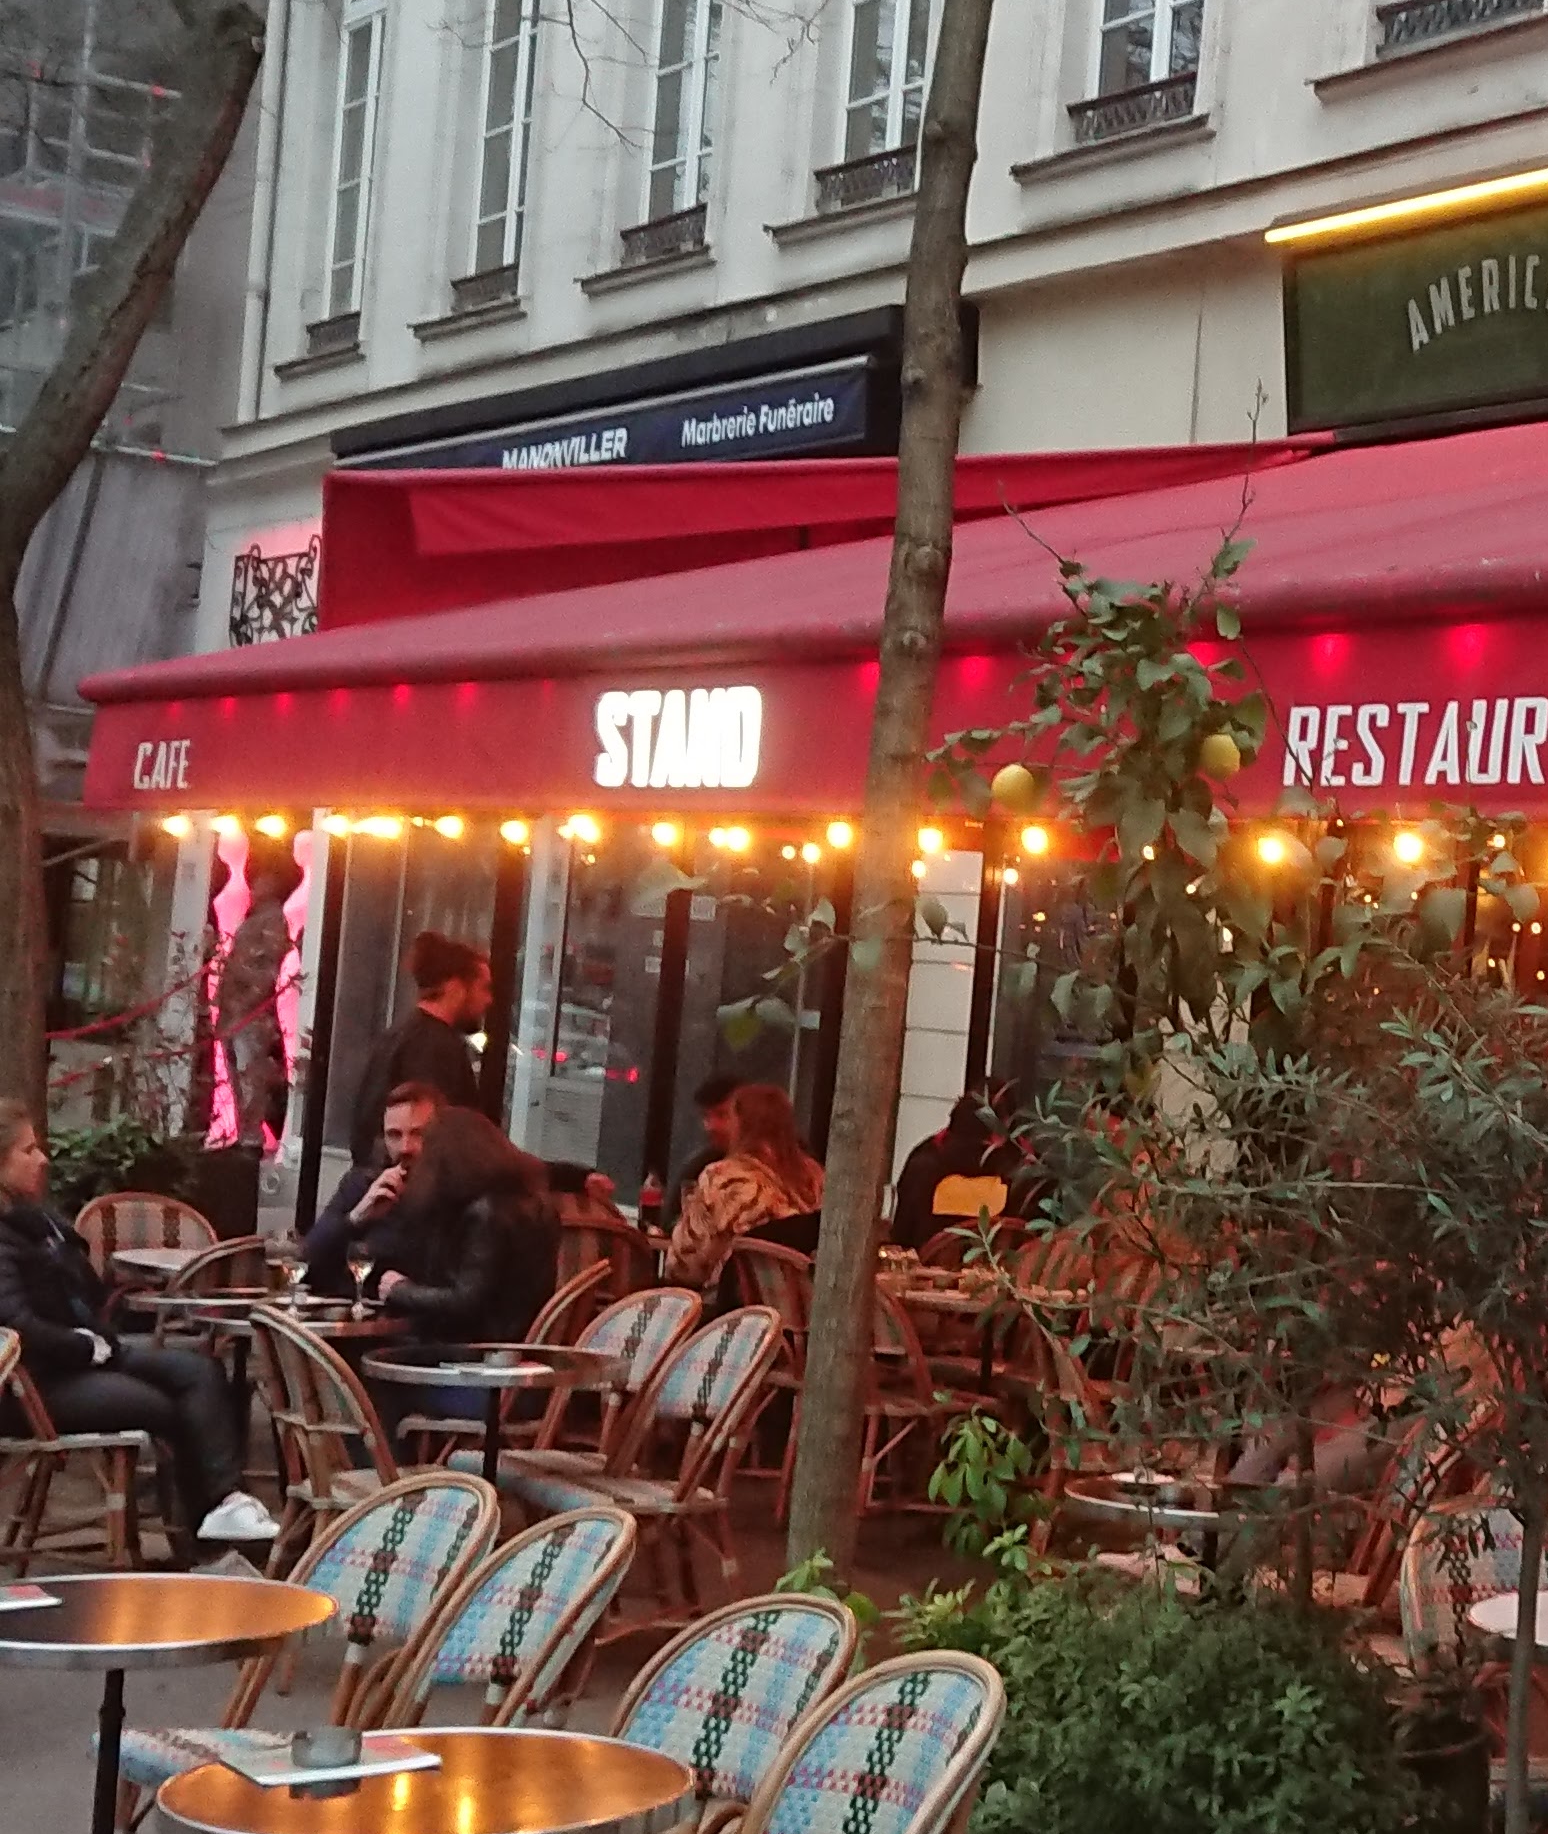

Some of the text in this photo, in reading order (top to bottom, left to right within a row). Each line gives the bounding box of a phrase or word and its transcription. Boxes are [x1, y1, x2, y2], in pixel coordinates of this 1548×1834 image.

[681, 392, 835, 448] Marbrerie Funéraire
[502, 427, 628, 470] MANONVILLER
[595, 685, 763, 788] STAND
[133, 738, 191, 790] CAFE
